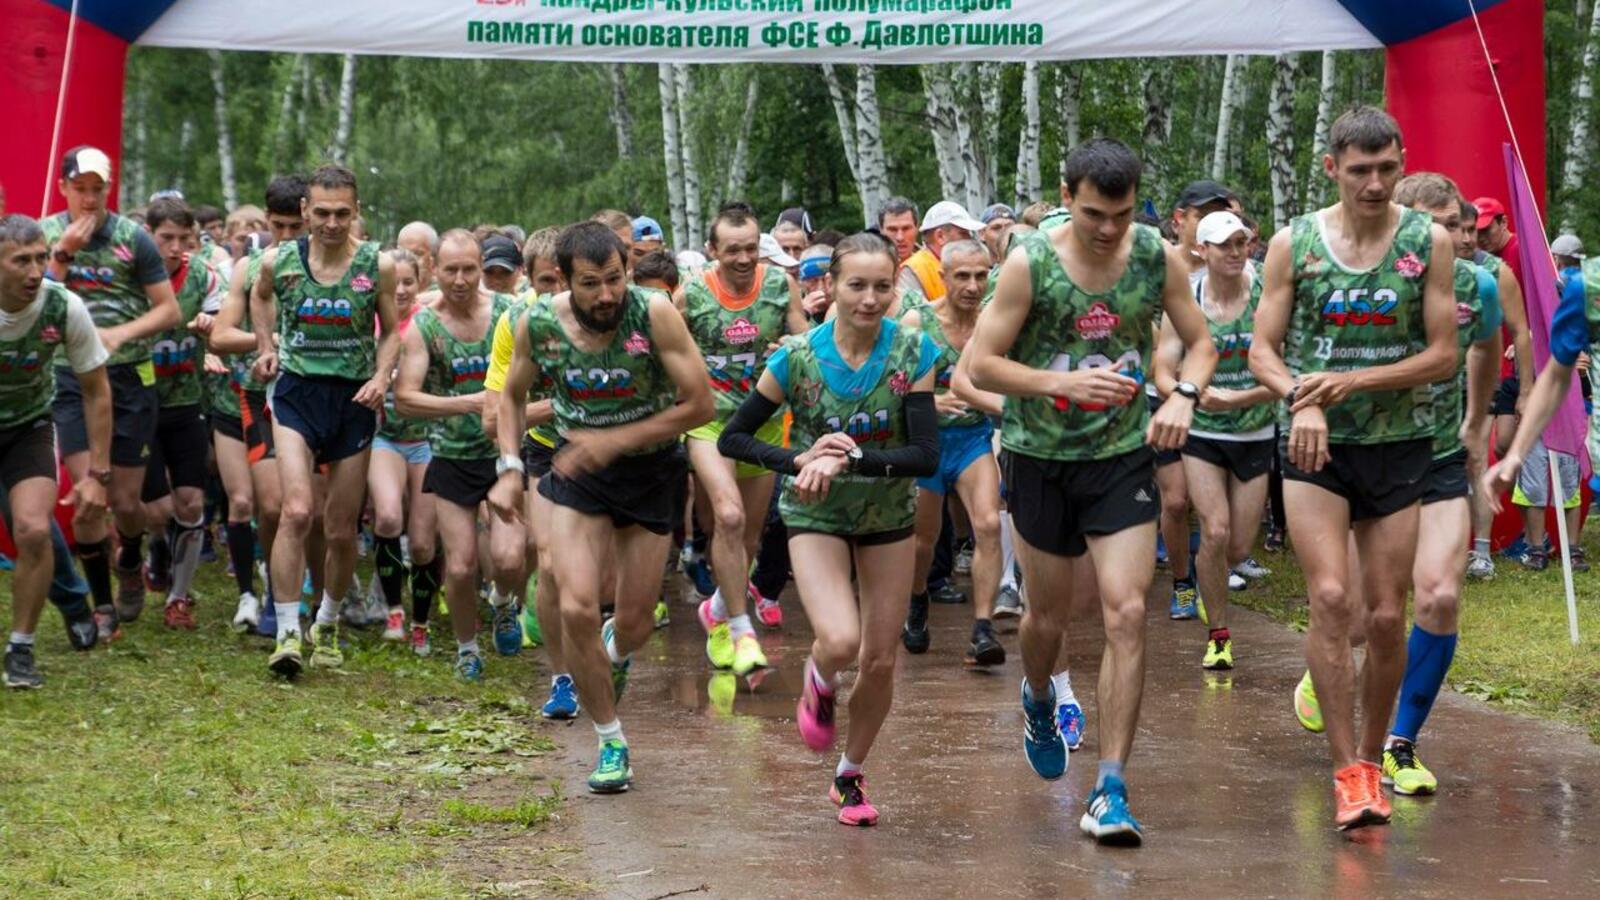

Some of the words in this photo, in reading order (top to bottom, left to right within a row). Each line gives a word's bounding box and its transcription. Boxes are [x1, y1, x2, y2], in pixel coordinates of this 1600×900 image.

[467, 21, 573, 46] памяти
[581, 23, 749, 48] основателя
[761, 21, 819, 48] ФСЕ
[297, 297, 352, 325] 429
[1322, 288, 1399, 327] 452
[1313, 336, 1333, 361] 23
[566, 368, 637, 400] 522
[826, 409, 890, 443] 101
